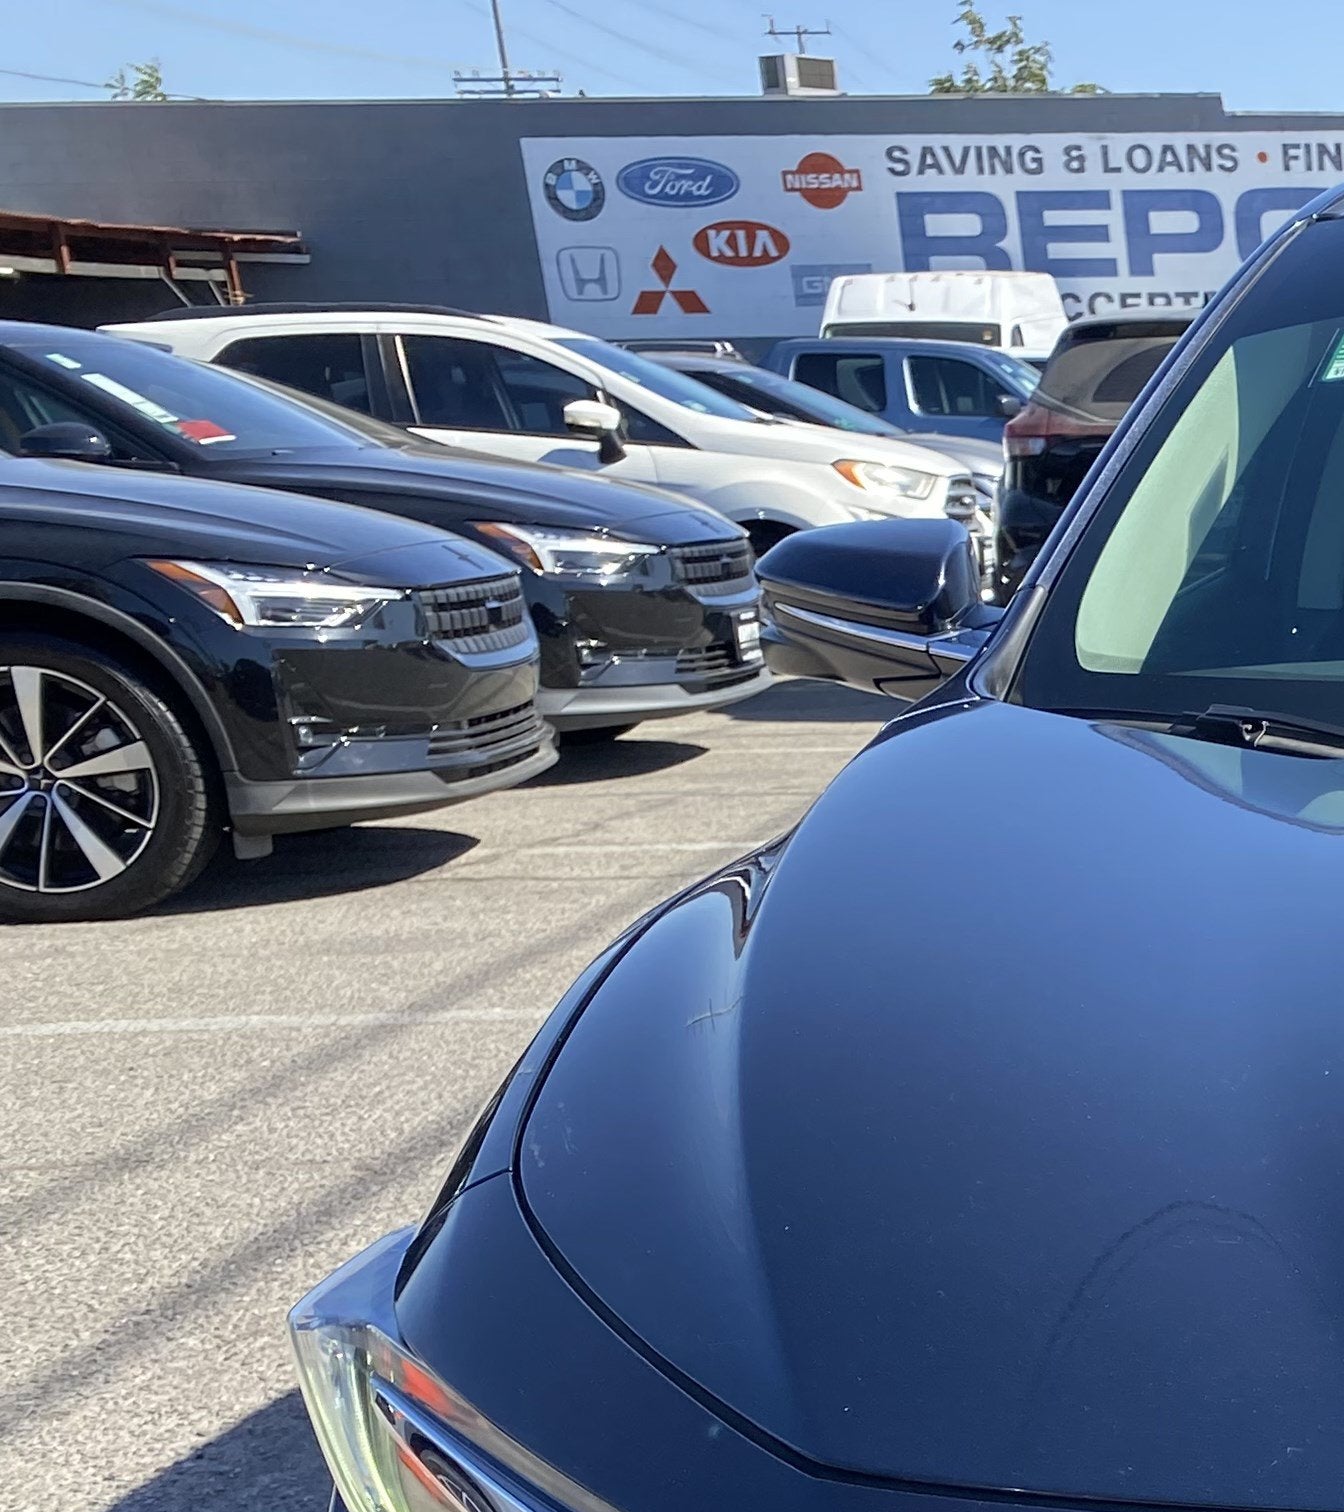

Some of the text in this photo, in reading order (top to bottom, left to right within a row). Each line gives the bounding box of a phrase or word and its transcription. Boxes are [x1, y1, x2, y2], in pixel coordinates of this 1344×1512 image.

[545, 159, 600, 186] BMW
[884, 144, 1044, 176] SAVING
[1064, 144, 1087, 174] &
[1101, 143, 1239, 174] LOANS
[644, 167, 714, 196] Ford
[785, 173, 859, 189] NISSAN
[706, 229, 779, 258] KIA
